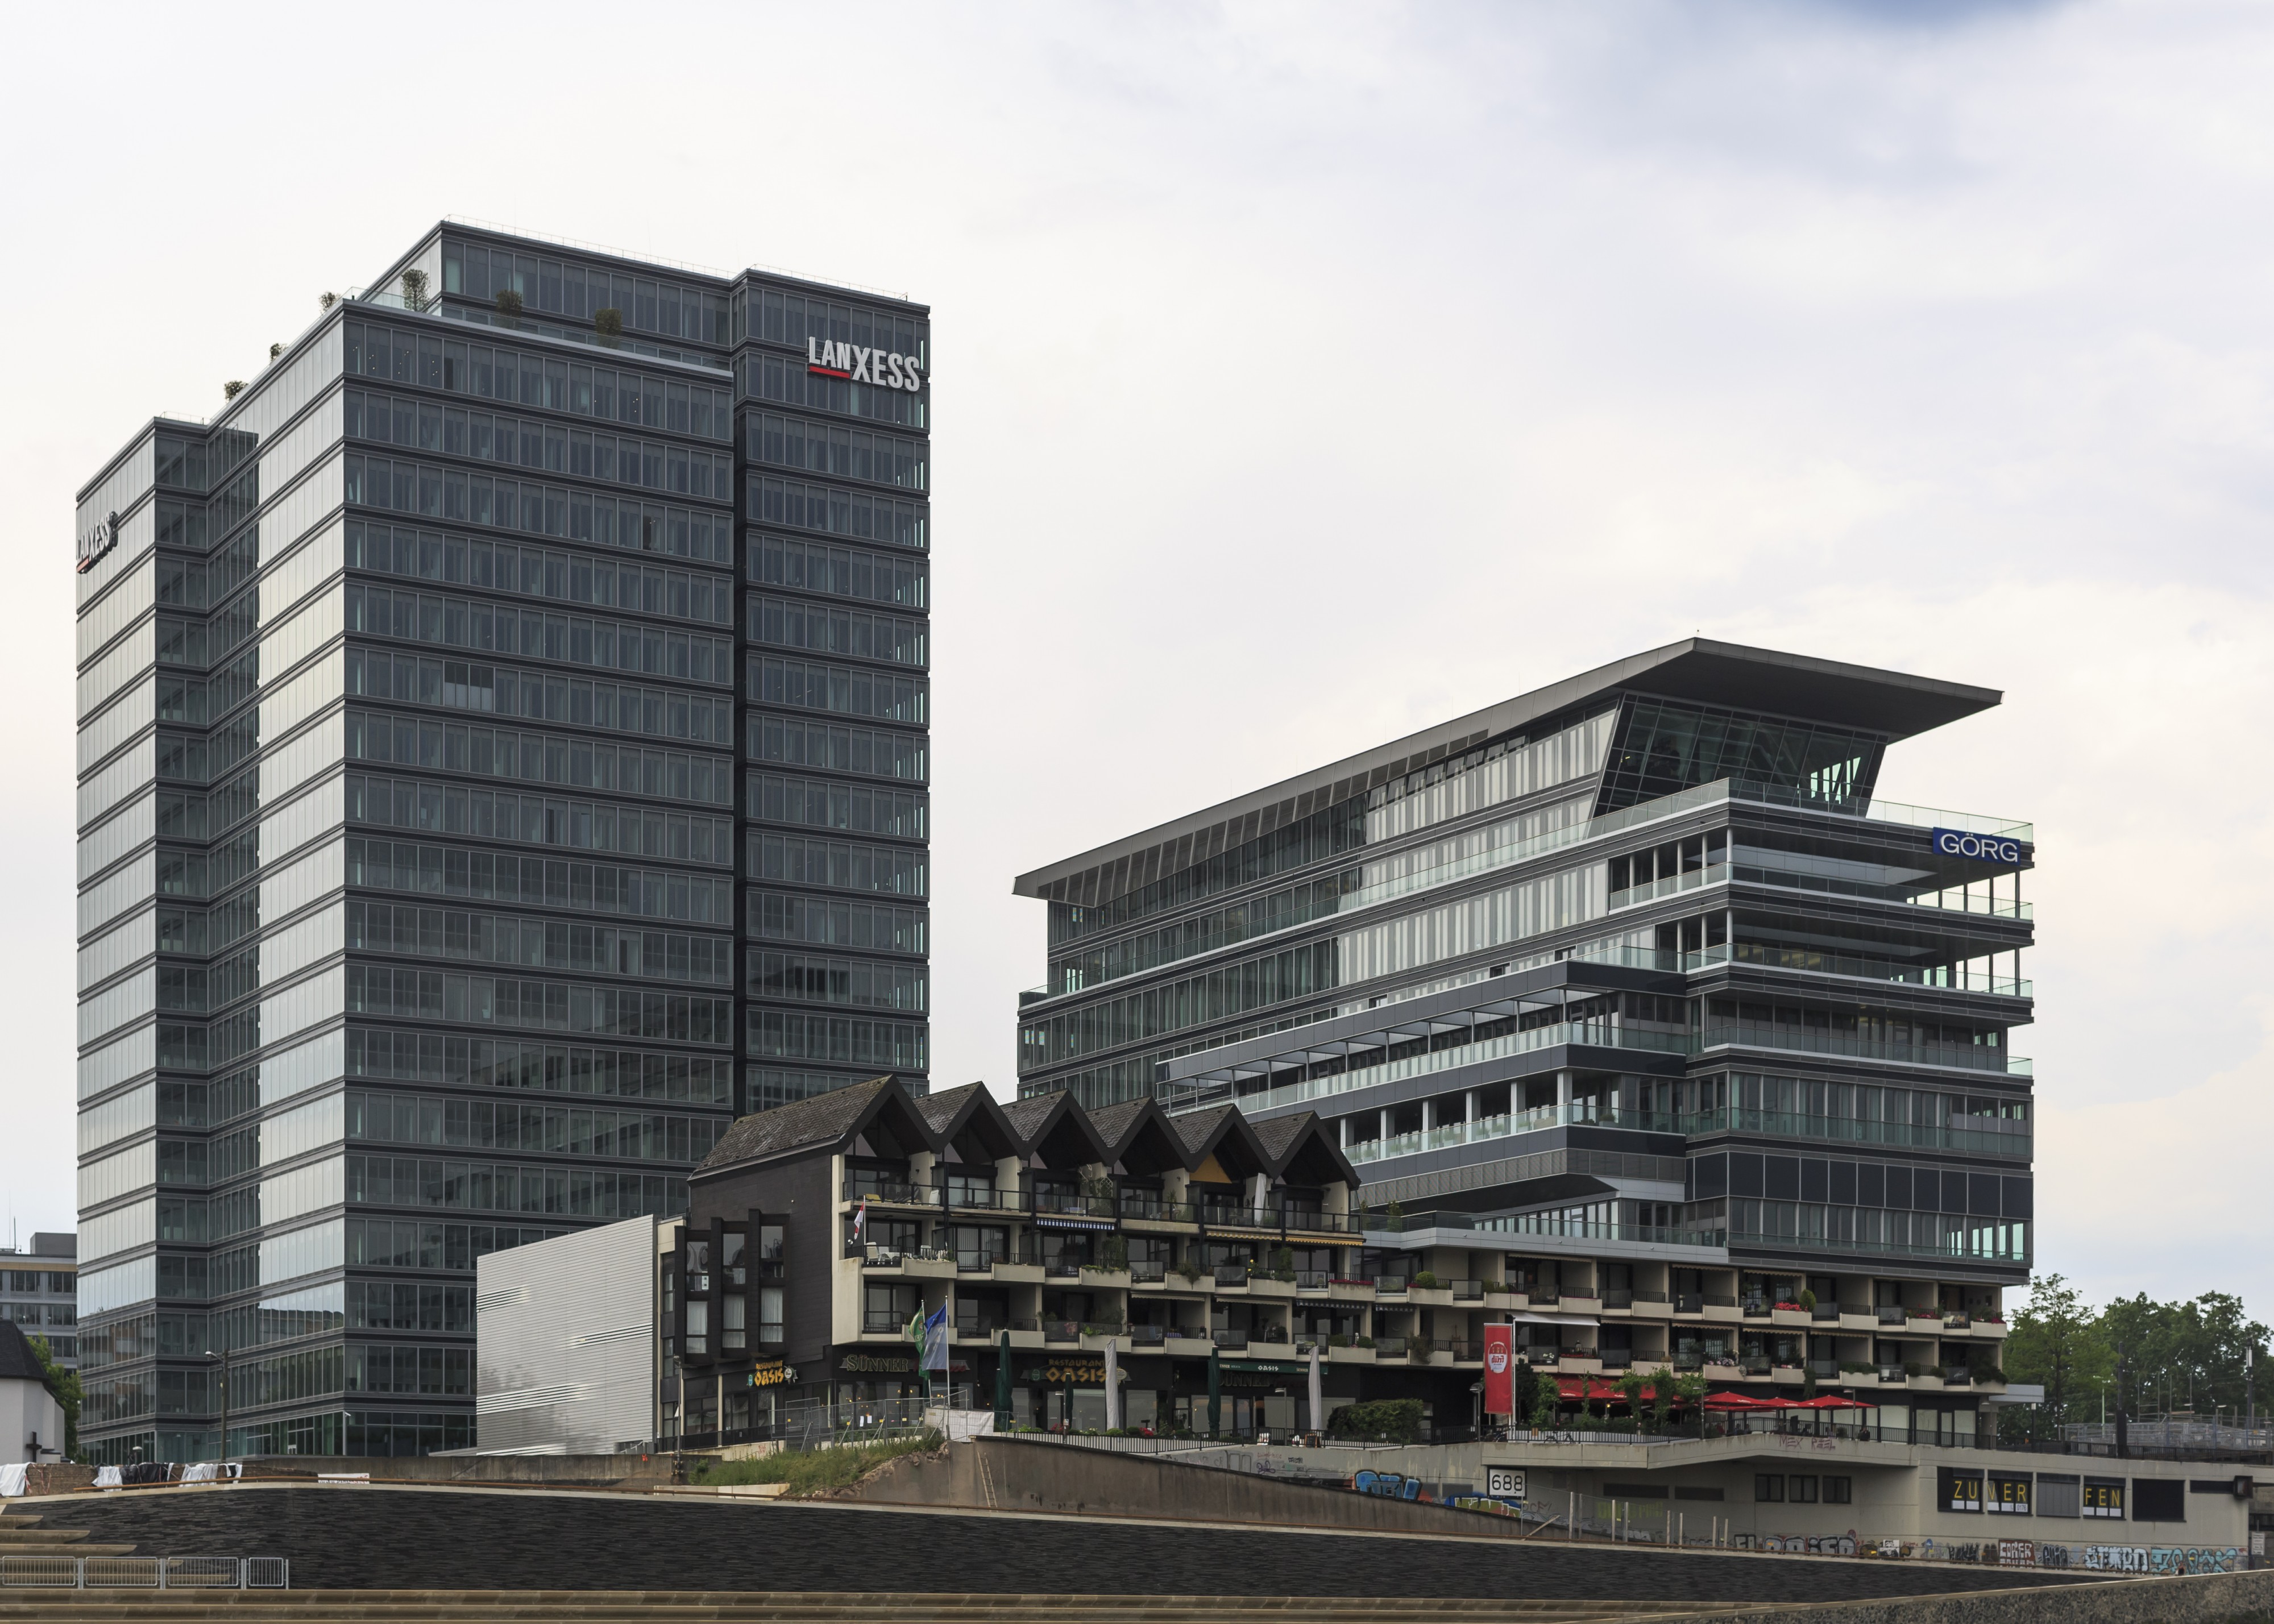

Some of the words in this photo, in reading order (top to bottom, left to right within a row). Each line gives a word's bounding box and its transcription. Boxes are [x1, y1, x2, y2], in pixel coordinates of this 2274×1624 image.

[809, 337, 920, 392] LANXESS
[1940, 833, 2018, 862] GÖRG
[846, 1355, 909, 1372] SÜNNER
[1048, 1359, 1106, 1367] RESTAURANT
[754, 1368, 784, 1386] OASIS
[1045, 1367, 1106, 1382] OASIS
[1492, 1474, 1523, 1492] 688
